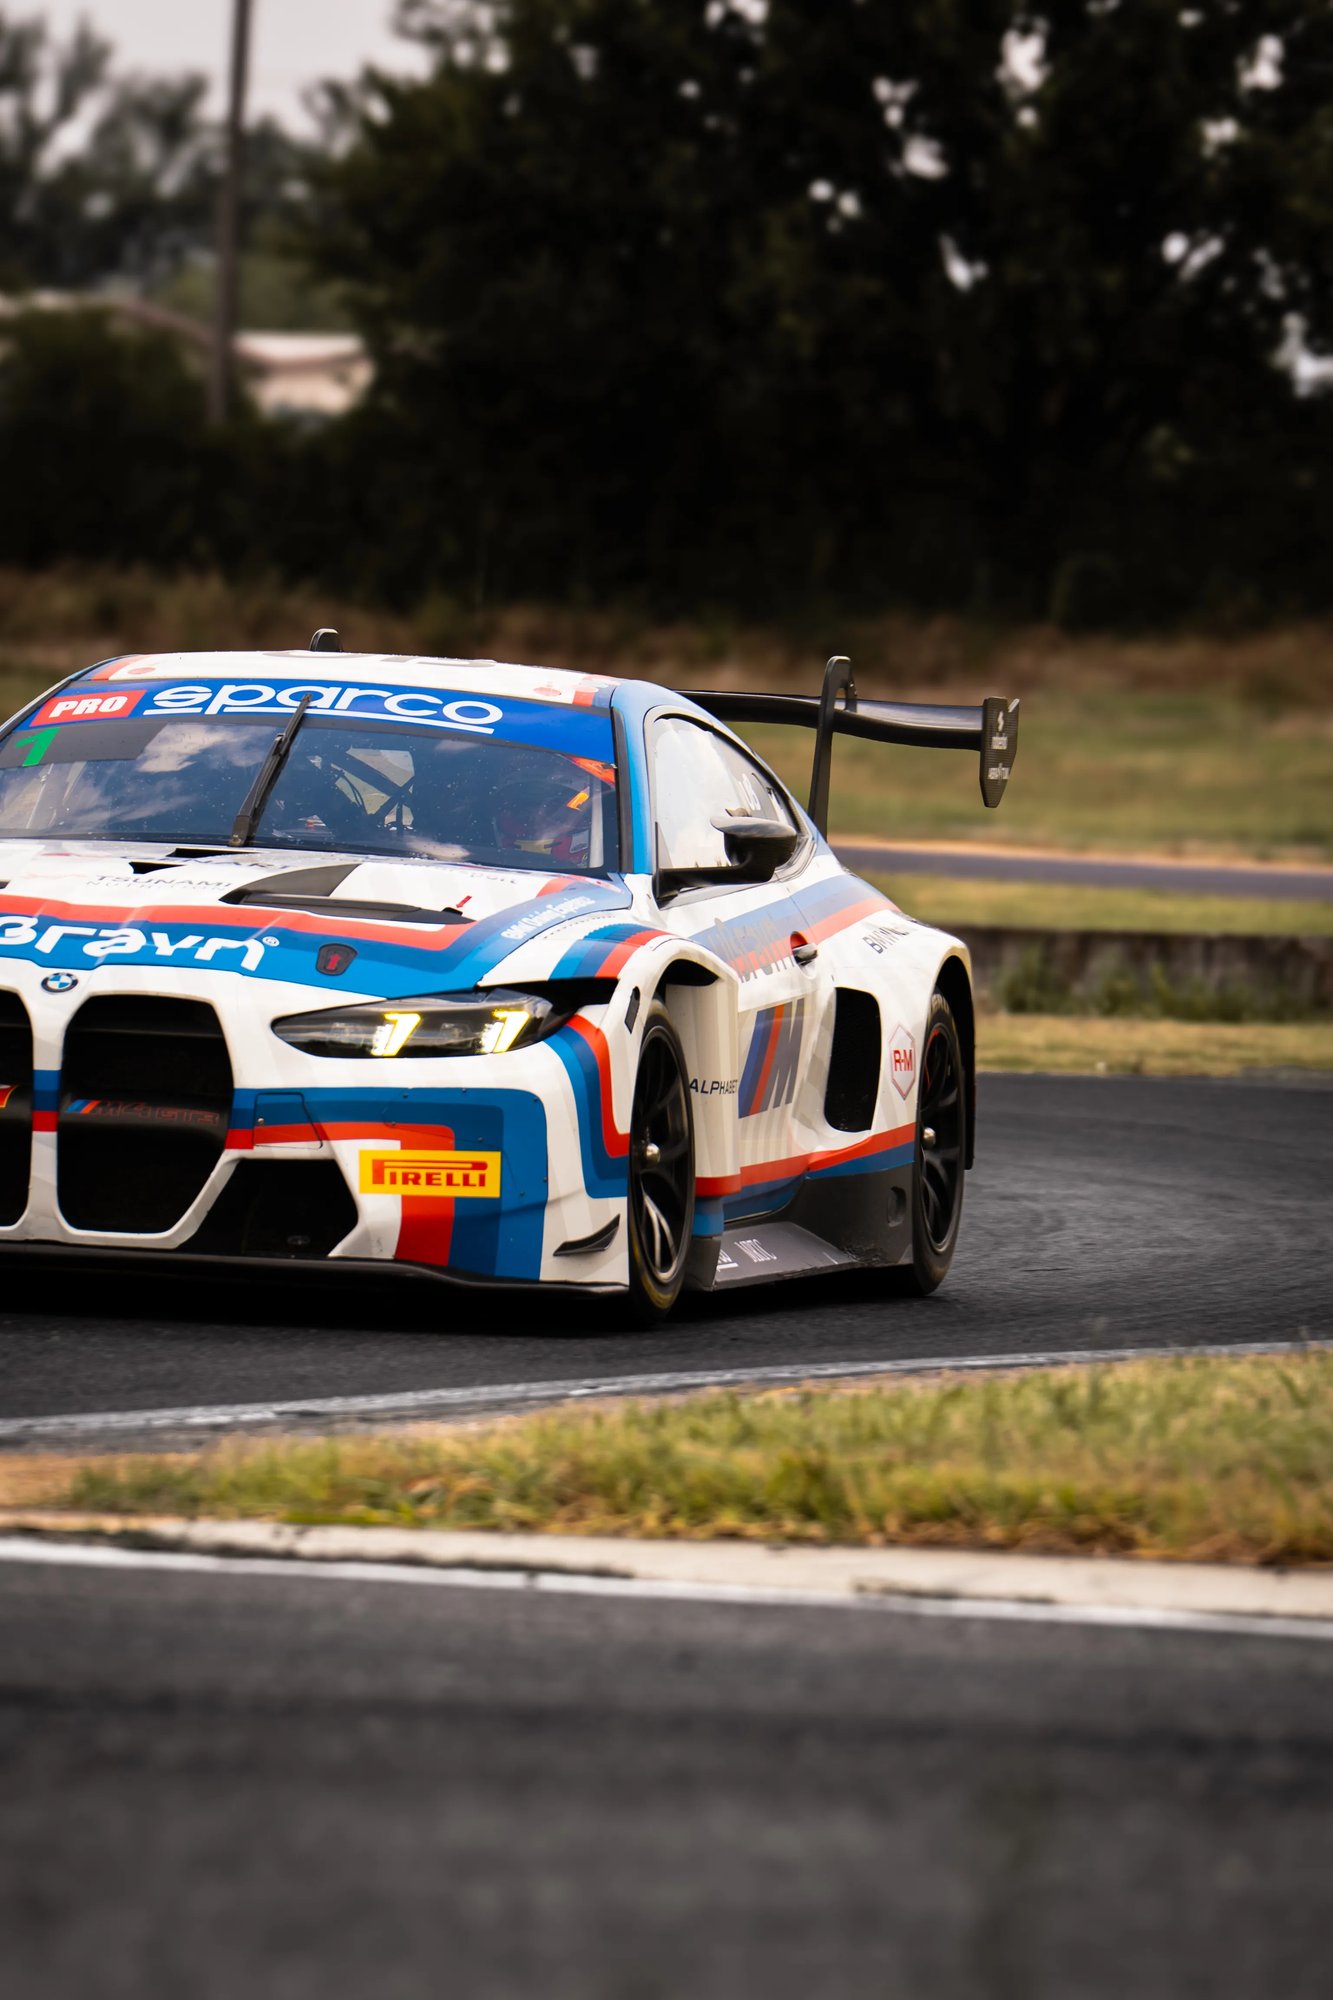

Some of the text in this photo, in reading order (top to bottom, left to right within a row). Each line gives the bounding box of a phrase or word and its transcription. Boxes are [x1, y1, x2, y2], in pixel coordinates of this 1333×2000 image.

[49, 695, 128, 718] PRO
[148, 684, 503, 730] sparco
[97, 875, 232, 888] TSUNAMI
[372, 1159, 488, 1187] PIRELLI
